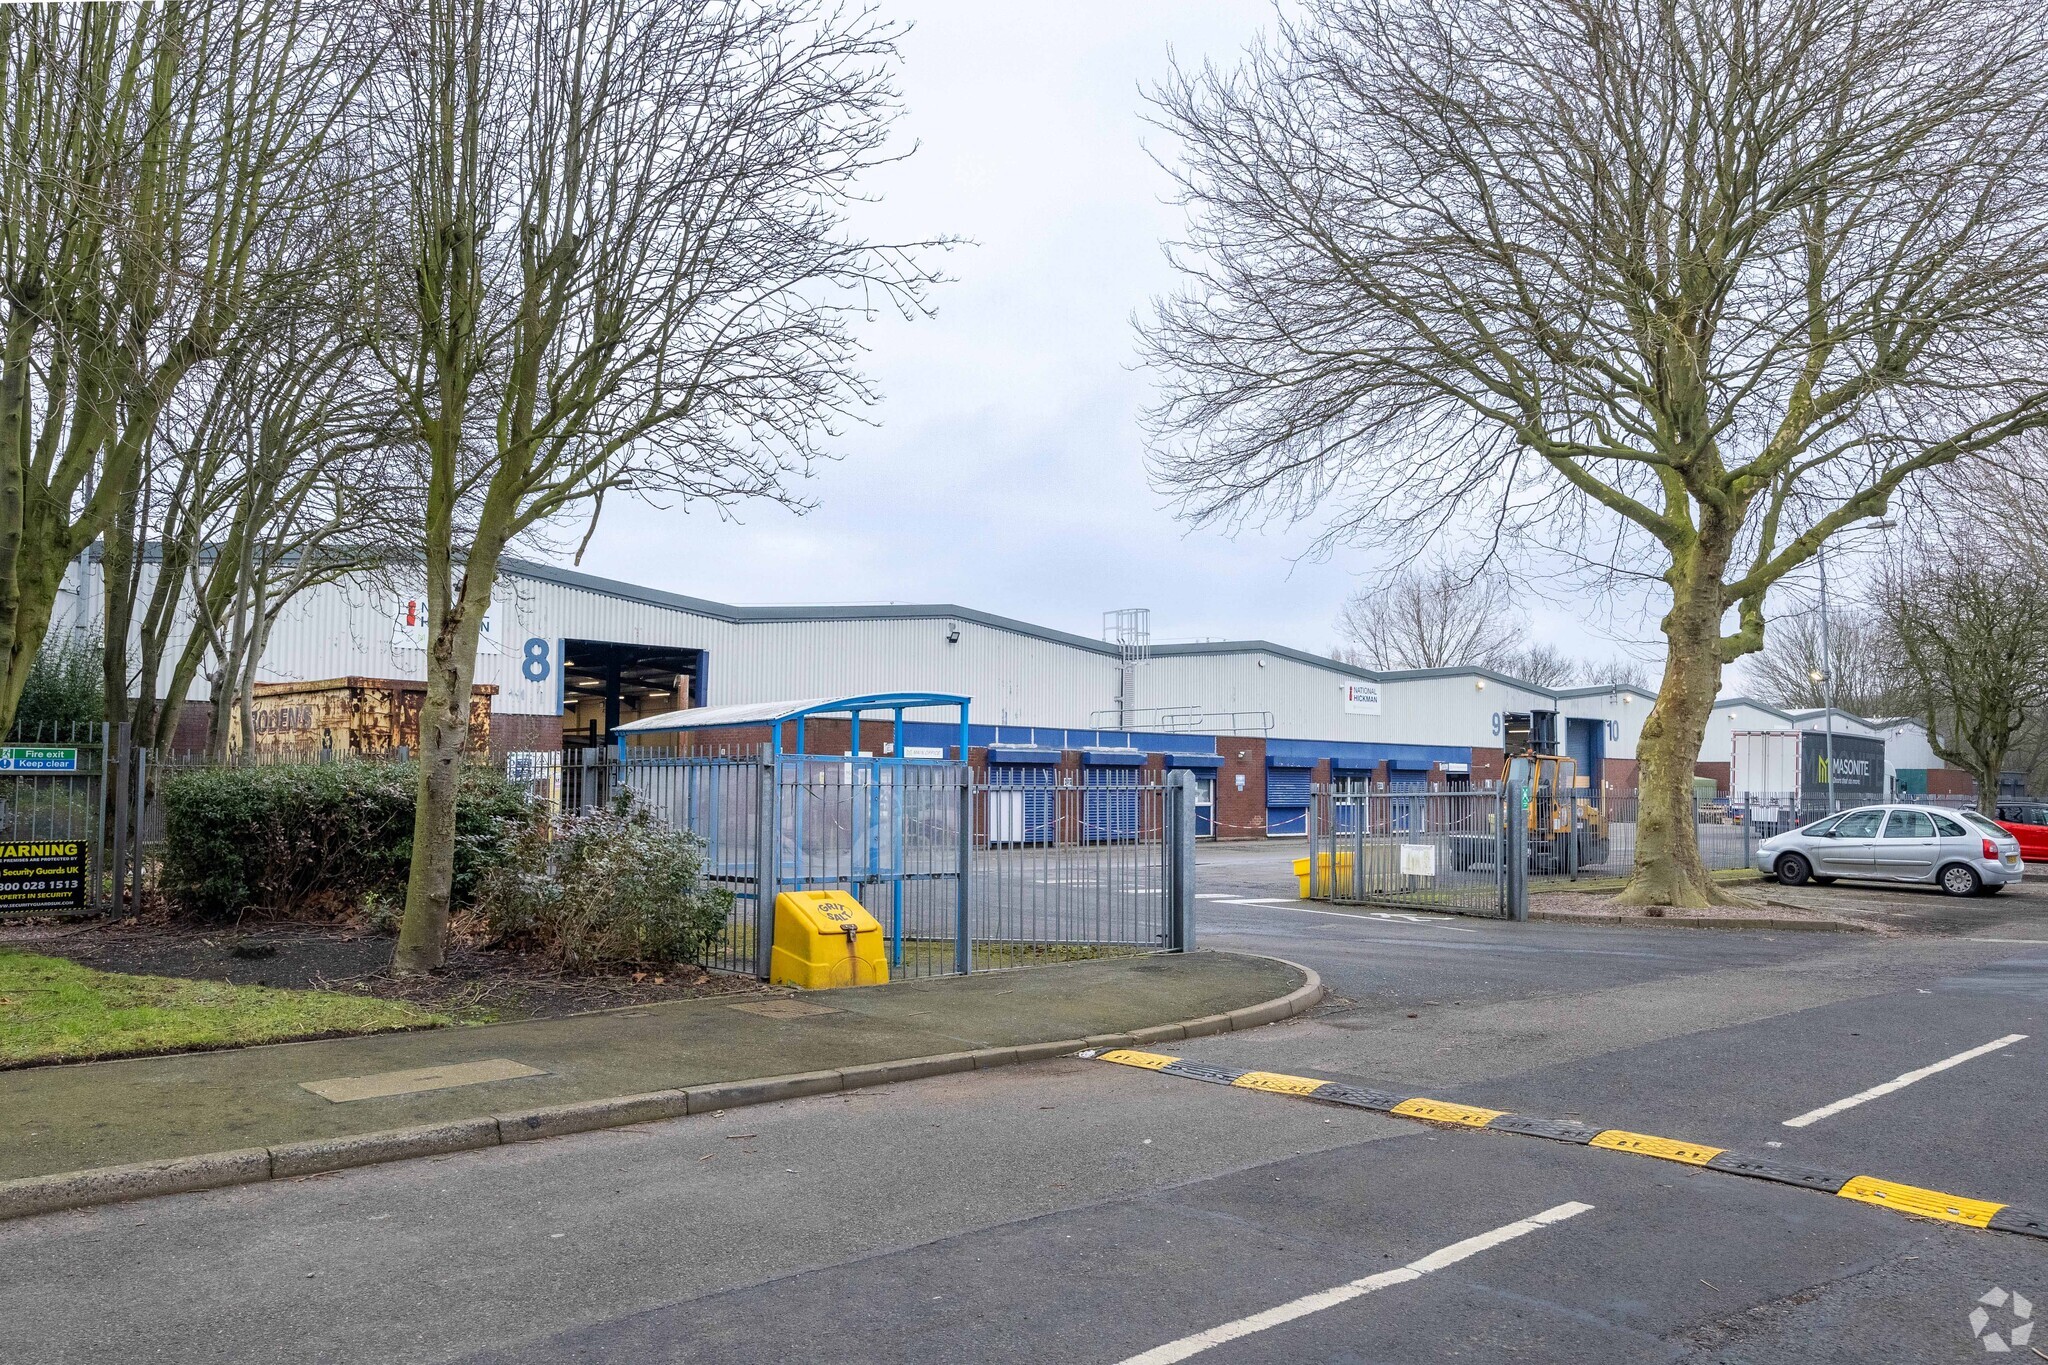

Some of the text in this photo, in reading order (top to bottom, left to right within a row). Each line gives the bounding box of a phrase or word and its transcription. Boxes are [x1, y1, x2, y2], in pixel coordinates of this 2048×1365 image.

[523, 638, 550, 682] 8
[1354, 687, 1377, 695] NATIONAL
[1354, 695, 1378, 703] HICKMAN
[1492, 712, 1501, 736] 9
[1606, 720, 1619, 742] 10
[25, 750, 65, 758] Fire exit
[19, 760, 69, 769] Keep clear
[1832, 758, 1869, 775] MASONITE
[3, 866, 79, 877] Security Guards UK
[22, 881, 46, 890] 028
[49, 880, 79, 889] 1513
[818, 903, 844, 912] GRIT
[826, 911, 852, 921] SALT
